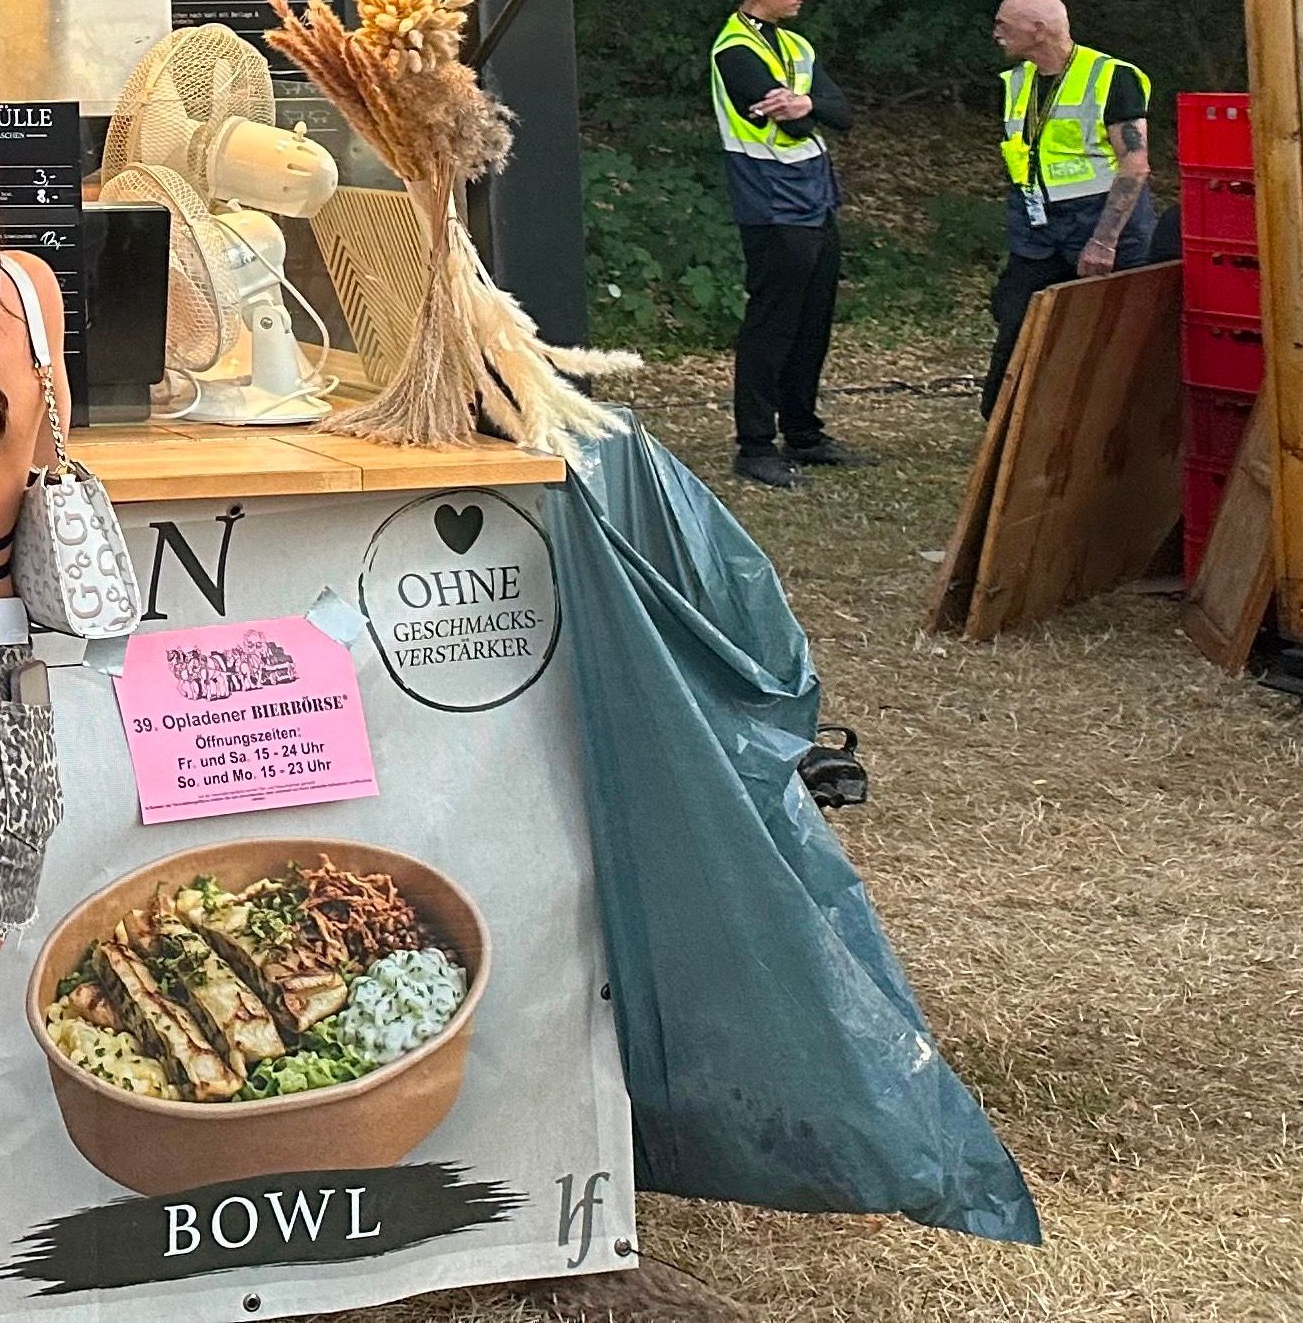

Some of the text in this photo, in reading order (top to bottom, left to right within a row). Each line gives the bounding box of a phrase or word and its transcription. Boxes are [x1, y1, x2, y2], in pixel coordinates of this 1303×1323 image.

[33, 168, 57, 186] 3,-
[397, 565, 521, 609] OHNE
[393, 609, 544, 643] GESCHMACKS-
[395, 637, 532, 669] VERSTÄRKER
[133, 717, 158, 734] 39.
[161, 708, 247, 731] Opladener
[195, 726, 302, 750] Öffnungszeiten:
[177, 757, 196, 771] Fr.
[200, 753, 226, 769] und
[229, 750, 251, 765] Sa.
[254, 747, 270, 761] 15
[281, 744, 298, 758] 24
[301, 741, 325, 755] Uhr
[177, 775, 199, 789] So.
[203, 771, 229, 786] und
[232, 767, 257, 782] Mo.
[260, 764, 277, 778] 15
[287, 761, 304, 775] 23
[307, 758, 332, 772] Uhr
[163, 1186, 382, 1257] BOWL
